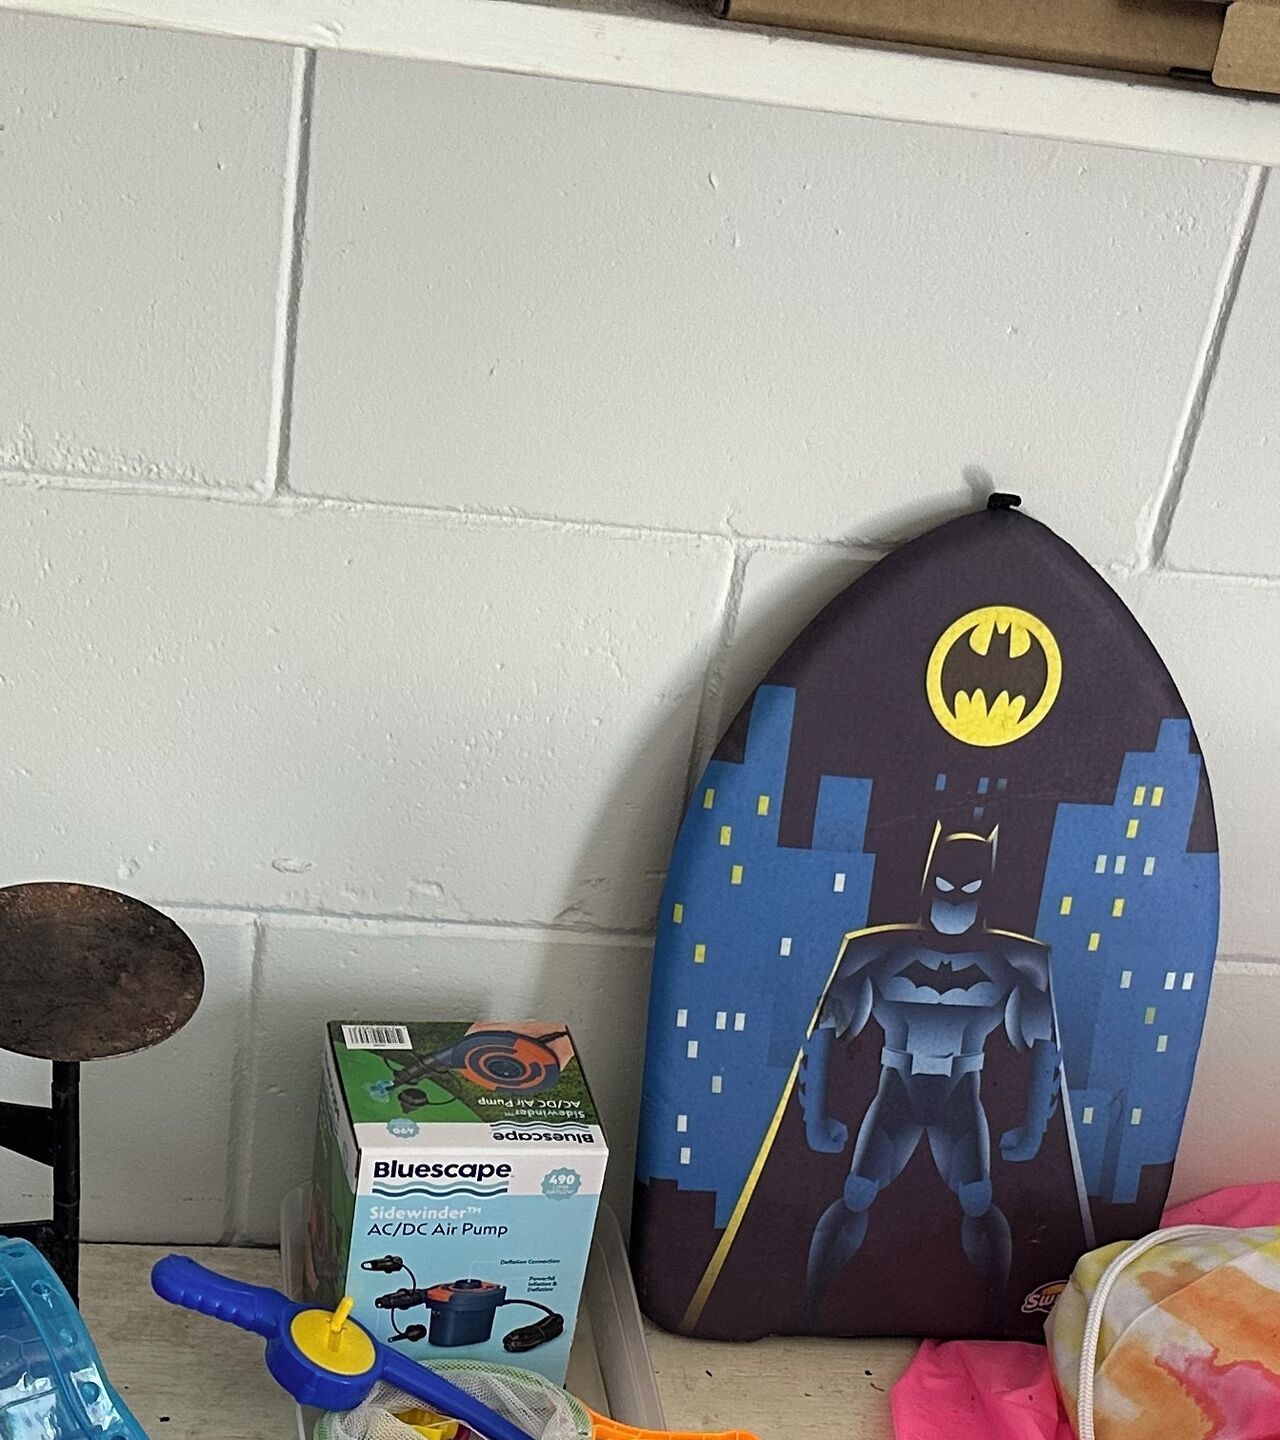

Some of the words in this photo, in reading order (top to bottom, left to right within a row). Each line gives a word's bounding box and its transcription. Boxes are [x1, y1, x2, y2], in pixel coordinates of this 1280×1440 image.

[478, 1097, 514, 1108] Pump
[517, 1098, 534, 1107] Air
[536, 1099, 580, 1108] AC/DC
[493, 1130, 595, 1143] Bluescape
[374, 1160, 512, 1181] Bluescape
[549, 1175, 575, 1185] 490
[367, 1222, 428, 1237] AC/DC
[431, 1223, 458, 1236] Air
[462, 1223, 509, 1238] Pump
